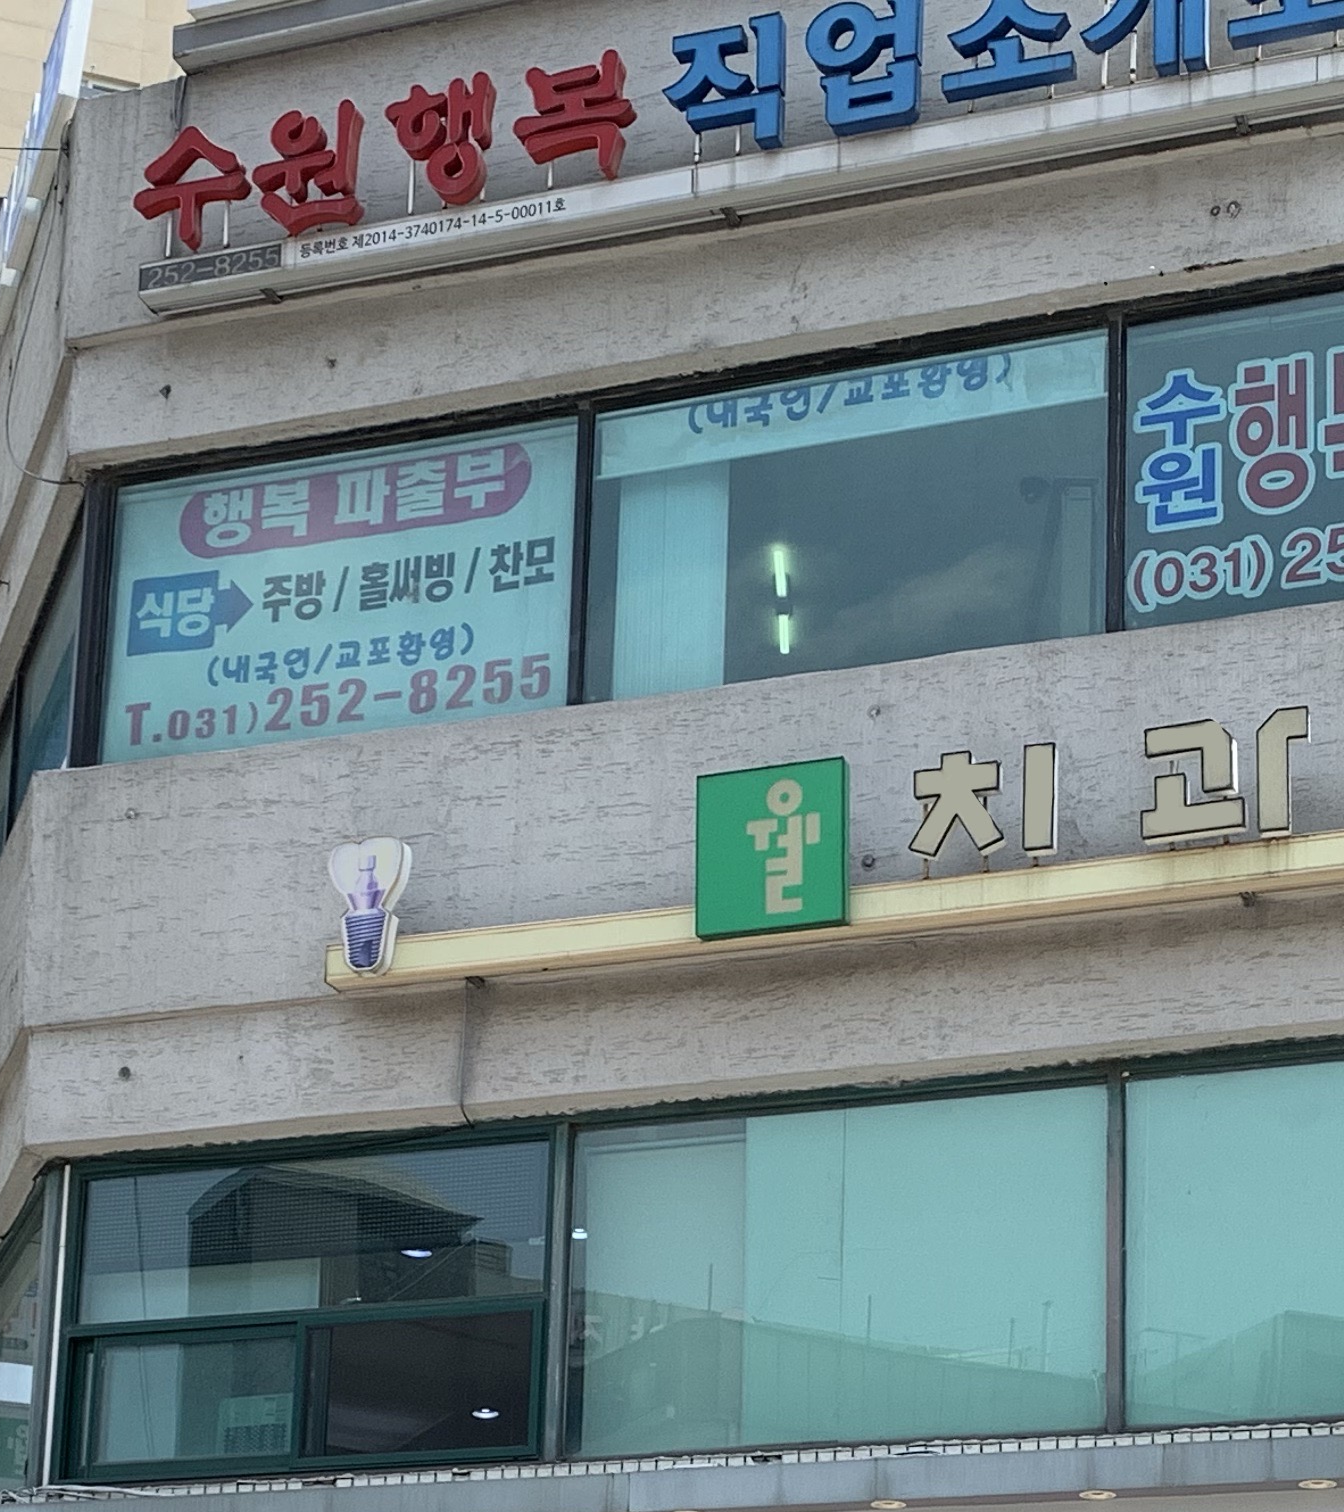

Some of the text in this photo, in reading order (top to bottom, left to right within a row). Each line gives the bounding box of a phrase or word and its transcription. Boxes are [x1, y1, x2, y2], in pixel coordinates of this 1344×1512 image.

[148, 247, 282, 288] 252-8255
[299, 235, 348, 259] 등록번호
[333, 447, 506, 525] 파출부
[135, 587, 215, 638] 식당
